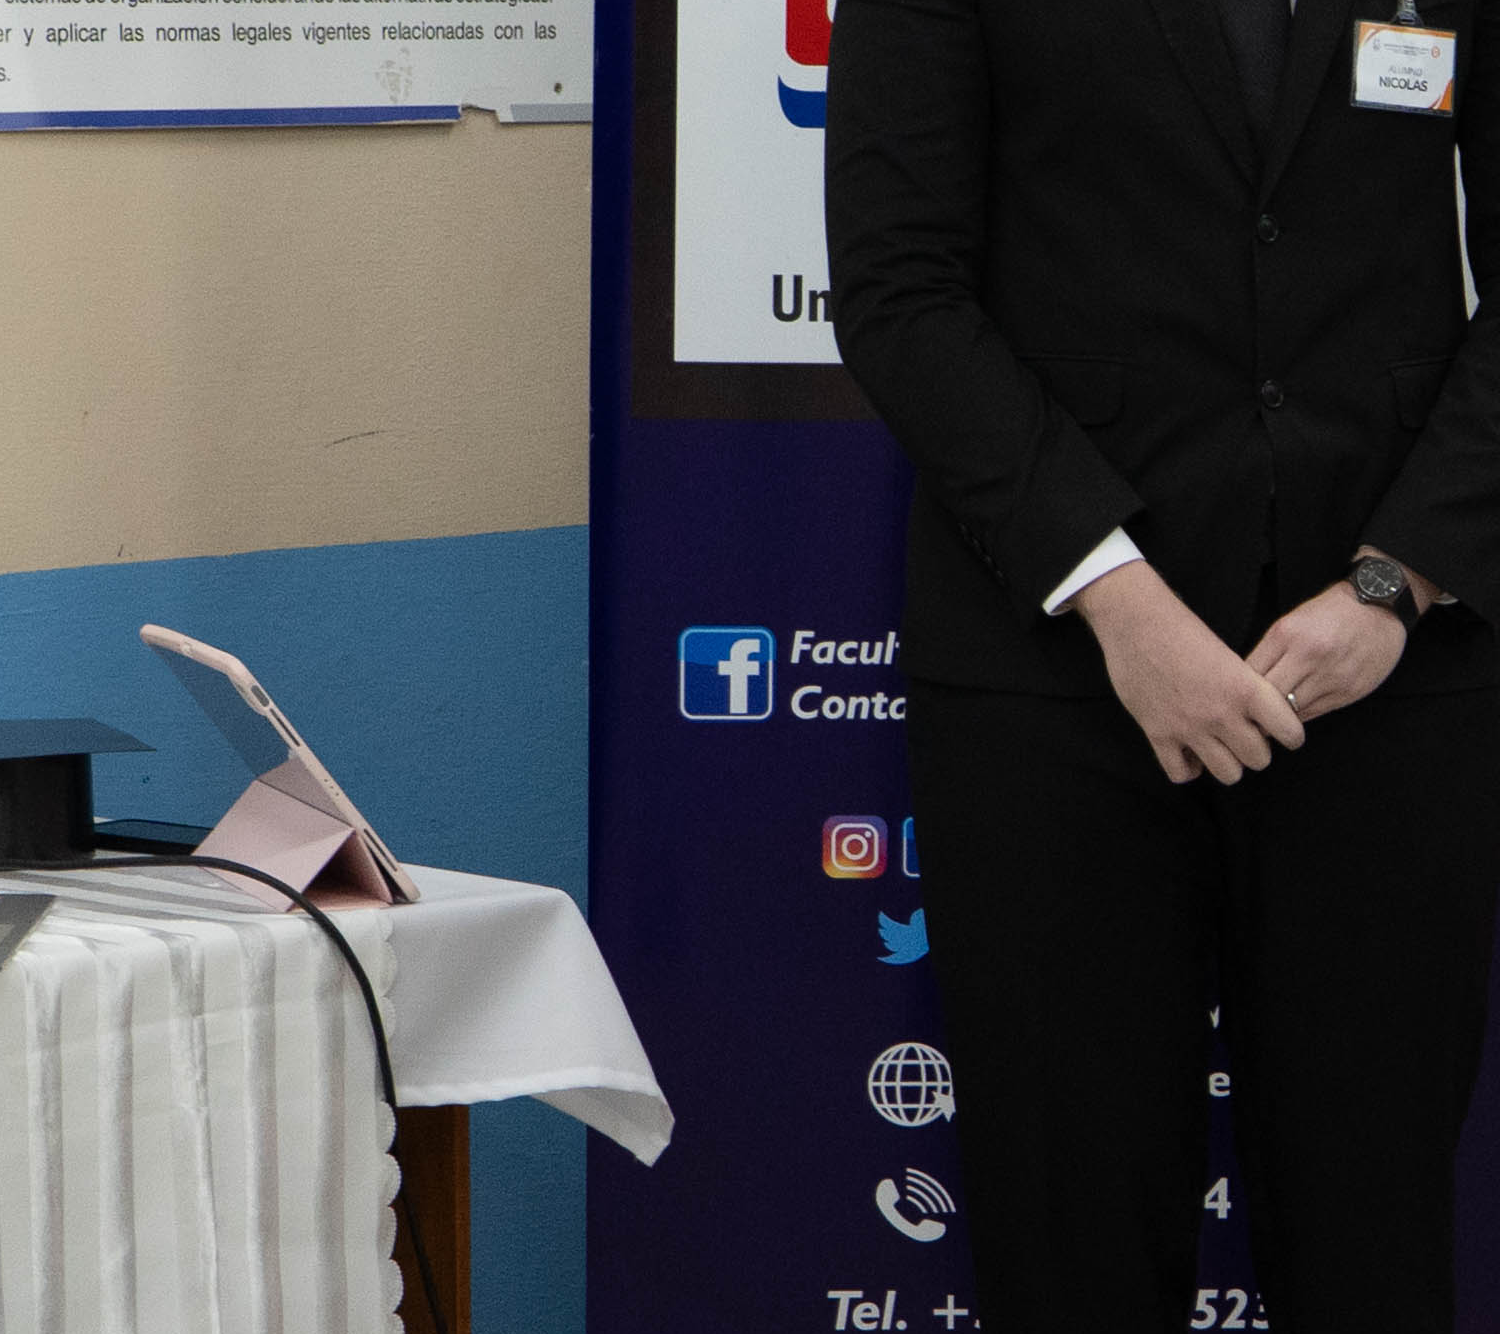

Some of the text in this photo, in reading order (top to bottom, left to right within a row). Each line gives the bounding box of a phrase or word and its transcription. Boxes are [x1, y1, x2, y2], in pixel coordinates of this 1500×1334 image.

[1379, 77, 1428, 92] NICOLAS
[791, 631, 899, 664] Facul
[828, 1290, 907, 1330] Tel.
